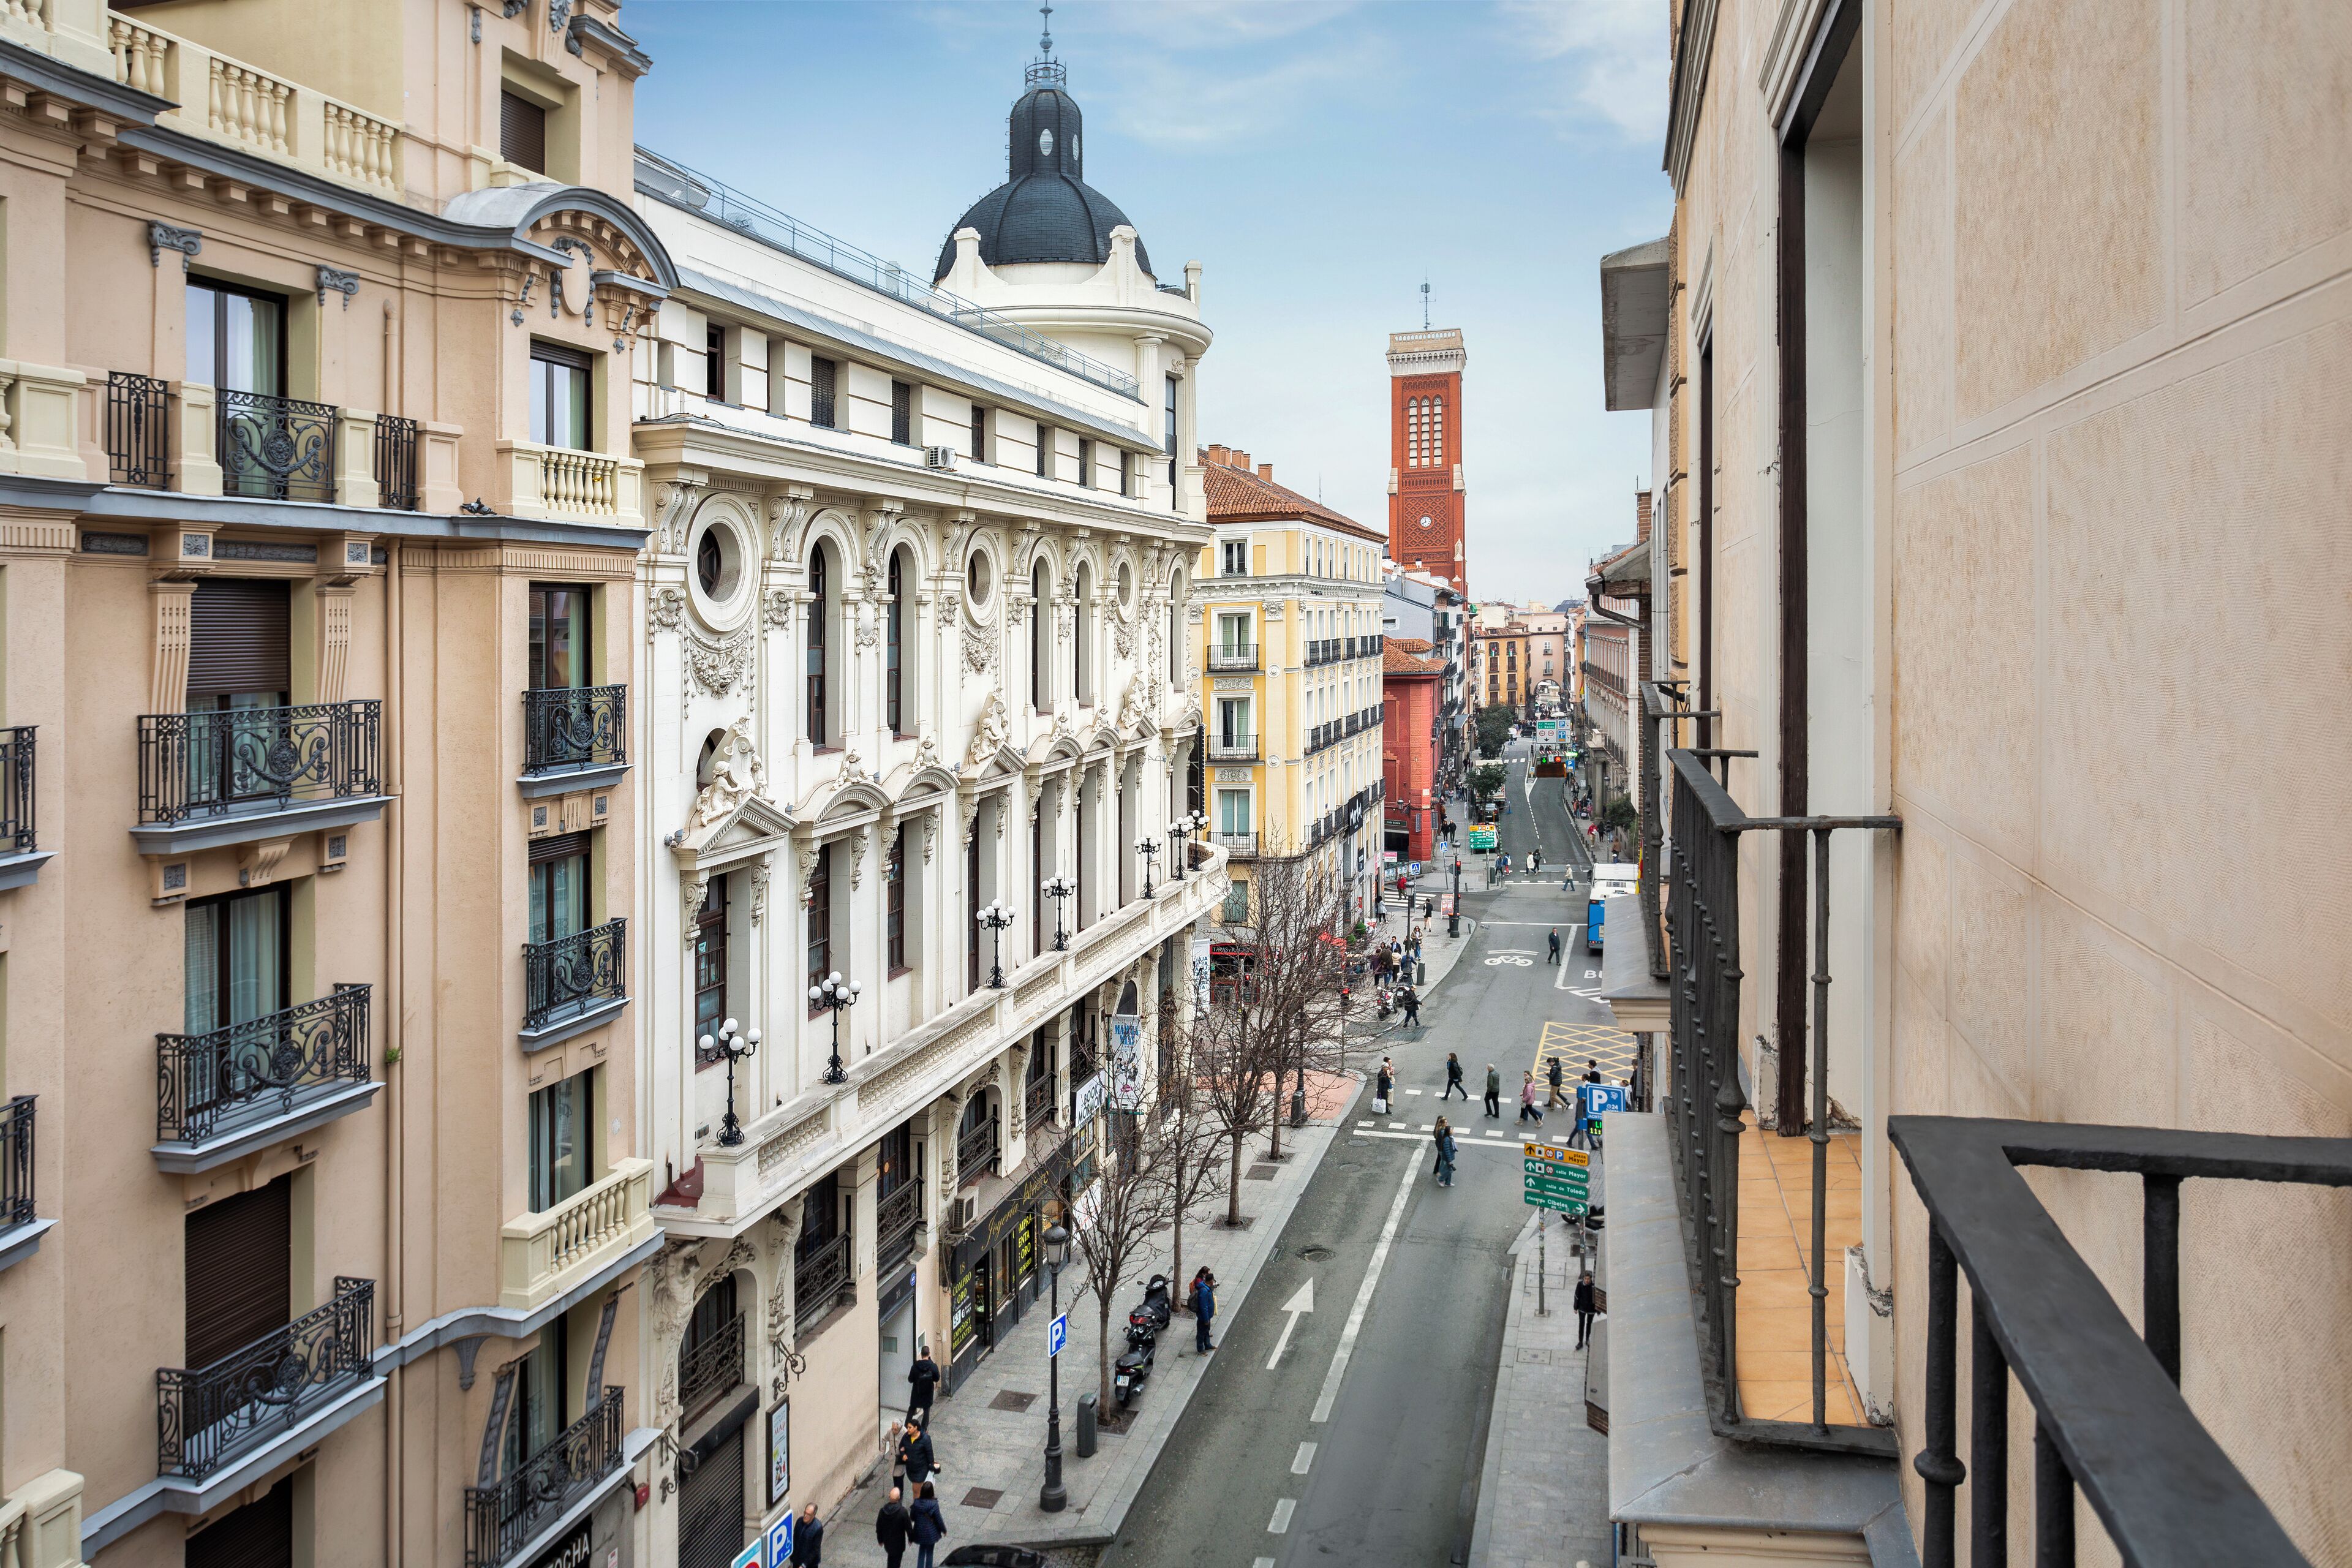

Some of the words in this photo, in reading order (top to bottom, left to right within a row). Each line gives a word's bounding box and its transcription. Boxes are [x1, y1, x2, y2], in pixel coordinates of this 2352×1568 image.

[1584, 970, 1602, 979] BU
[1084, 1084, 1098, 1106] BOOK
[1593, 1089, 1608, 1112] P
[1566, 1187, 1586, 1196] Toledo
[1547, 1199, 1568, 1208] Cibeles
[1019, 1229, 1030, 1248] ENTA
[1020, 1242, 1031, 1259] ORO
[960, 1262, 965, 1274] 18
[952, 1271, 971, 1297] COMPRO
[957, 1287, 967, 1304] ORO
[1052, 1322, 1063, 1352] P
[772, 1525, 787, 1567] P
